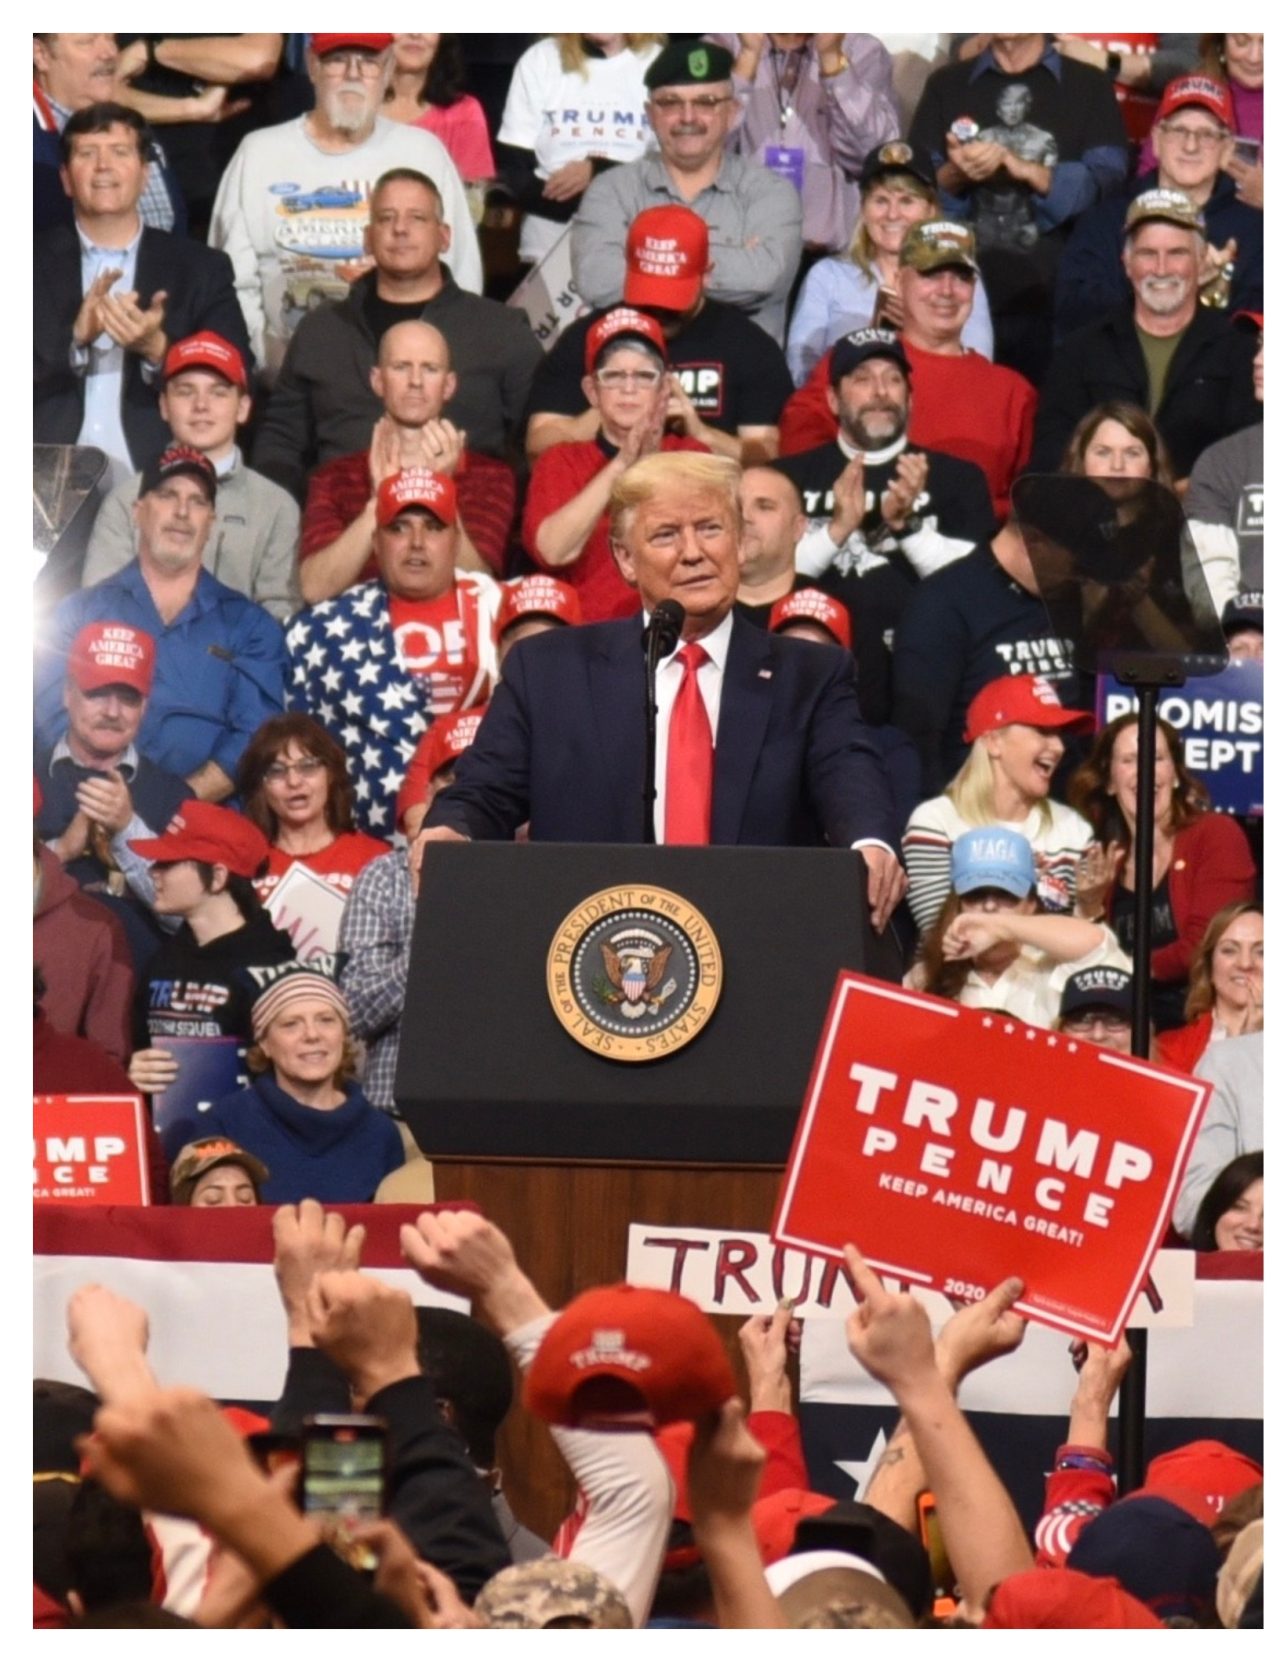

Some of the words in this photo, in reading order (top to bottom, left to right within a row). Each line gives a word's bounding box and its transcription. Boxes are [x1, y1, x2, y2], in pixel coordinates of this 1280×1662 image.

[551, 126, 645, 141] PENCE
[645, 236, 677, 250] KEEP
[671, 369, 719, 393] MP
[401, 467, 433, 479] KEEP
[522, 574, 557, 587] KEEP
[103, 627, 137, 641] KEEP
[88, 639, 144, 659] AMERICA
[94, 652, 137, 669] GREAT
[1106, 696, 1262, 735] POMIS
[1183, 740, 1260, 773] EPT
[659, 899, 681, 915] THE
[554, 892, 634, 967] PRESIDENT
[684, 915, 717, 988] UNITED
[555, 972, 566, 996] THE
[571, 1021, 615, 1052] SEAL
[646, 1003, 707, 1053] STATES
[849, 1062, 1154, 1189] TRUMP
[31, 1137, 125, 1163] MP
[862, 1126, 1116, 1228] PENCE
[878, 1173, 929, 1199] KEEP
[932, 1189, 1018, 1227] AMERICA
[1023, 1215, 1084, 1247] GREAT!
[643, 1243, 909, 1313] TRUM
[944, 1277, 986, 1301] 2020
